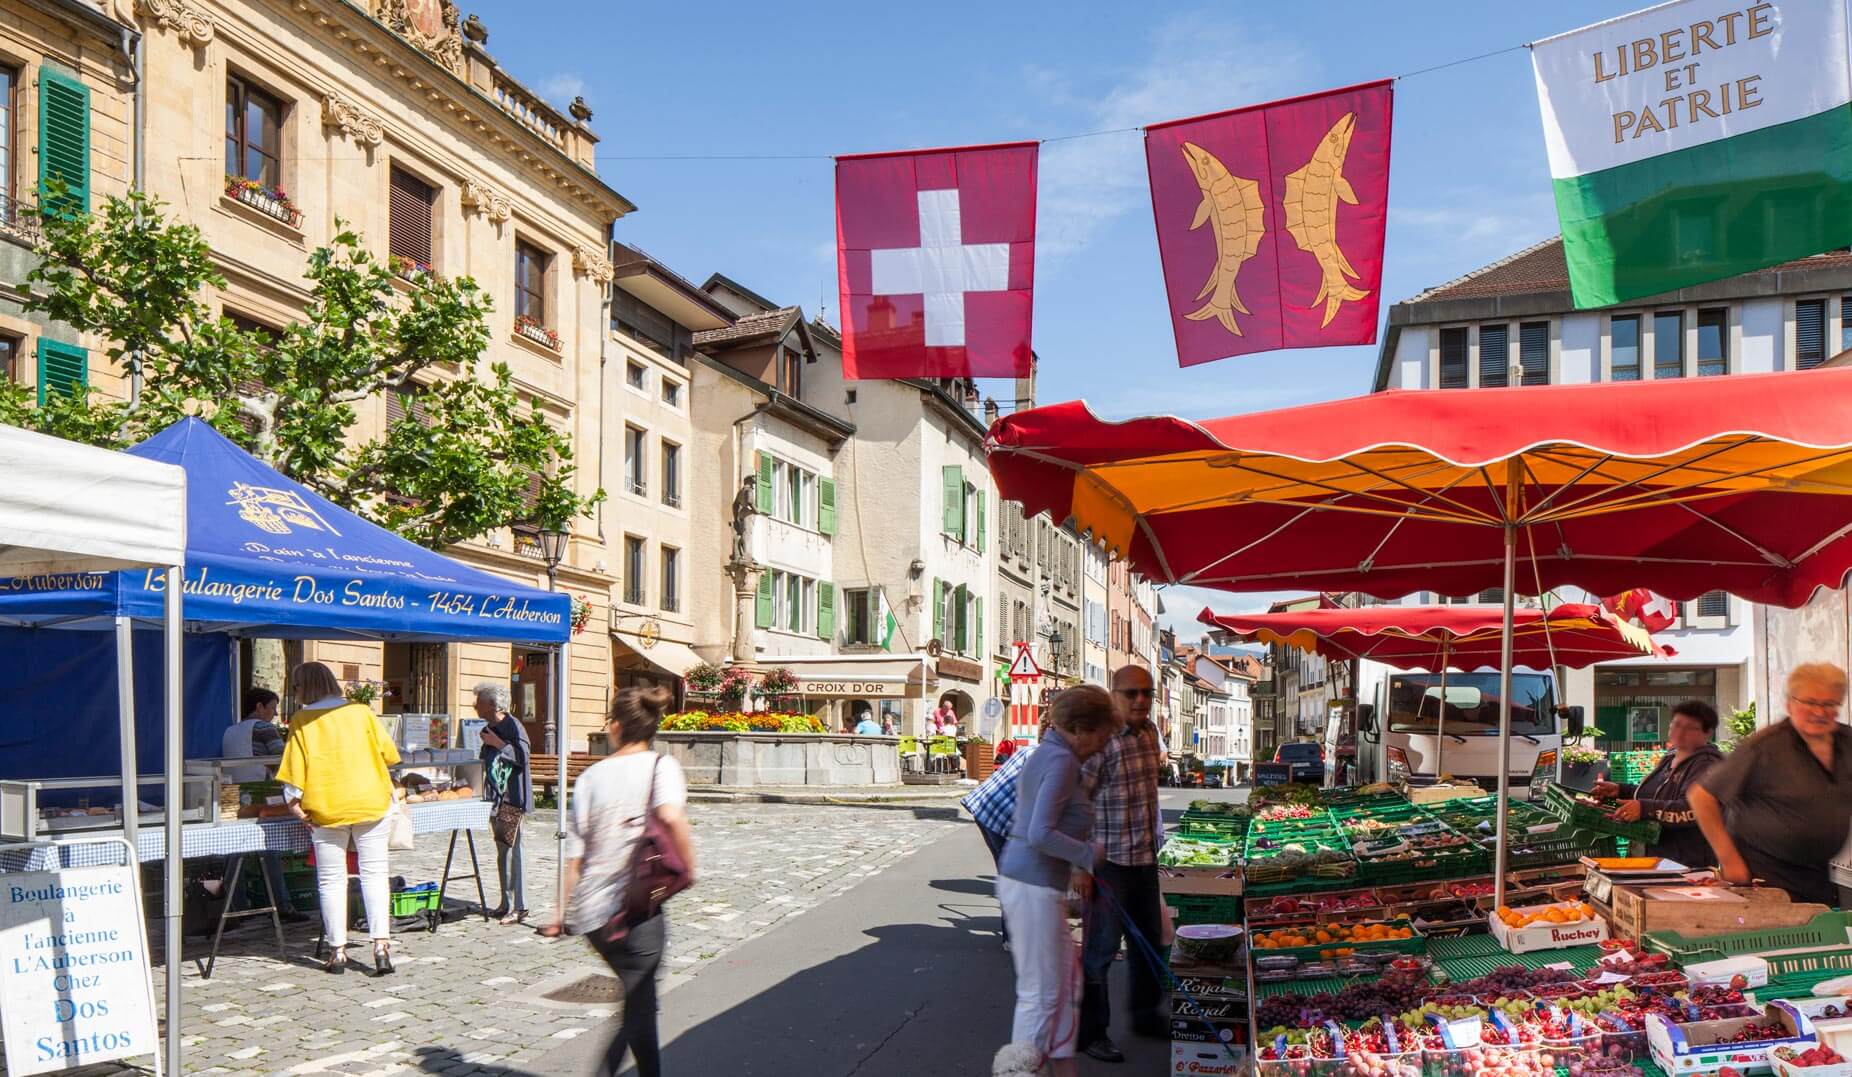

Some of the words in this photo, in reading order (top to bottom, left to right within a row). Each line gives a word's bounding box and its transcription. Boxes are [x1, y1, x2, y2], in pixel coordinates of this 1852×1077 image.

[1593, 0, 1776, 83] LIBERTÉ
[1664, 63, 1700, 91] ET
[1612, 75, 1764, 144] PATRIE
[240, 542, 304, 557] Pain
[0, 574, 103, 590] Auberson
[143, 567, 282, 604] Bulangerie
[293, 575, 334, 604] Dos
[342, 579, 404, 609] Santos
[428, 591, 474, 617] 1454
[479, 595, 561, 624] L'Auberson
[806, 683, 845, 693] CROIX
[852, 683, 884, 693] D'OR
[10, 880, 122, 903] Boulangerie
[64, 907, 76, 923] à
[24, 929, 119, 950] l'ancienne
[1551, 927, 1600, 942] Ruchey
[13, 949, 133, 974] L'Auberson
[54, 975, 101, 992] Chez
[54, 999, 109, 1023] Dos
[36, 1031, 132, 1062] Santos
